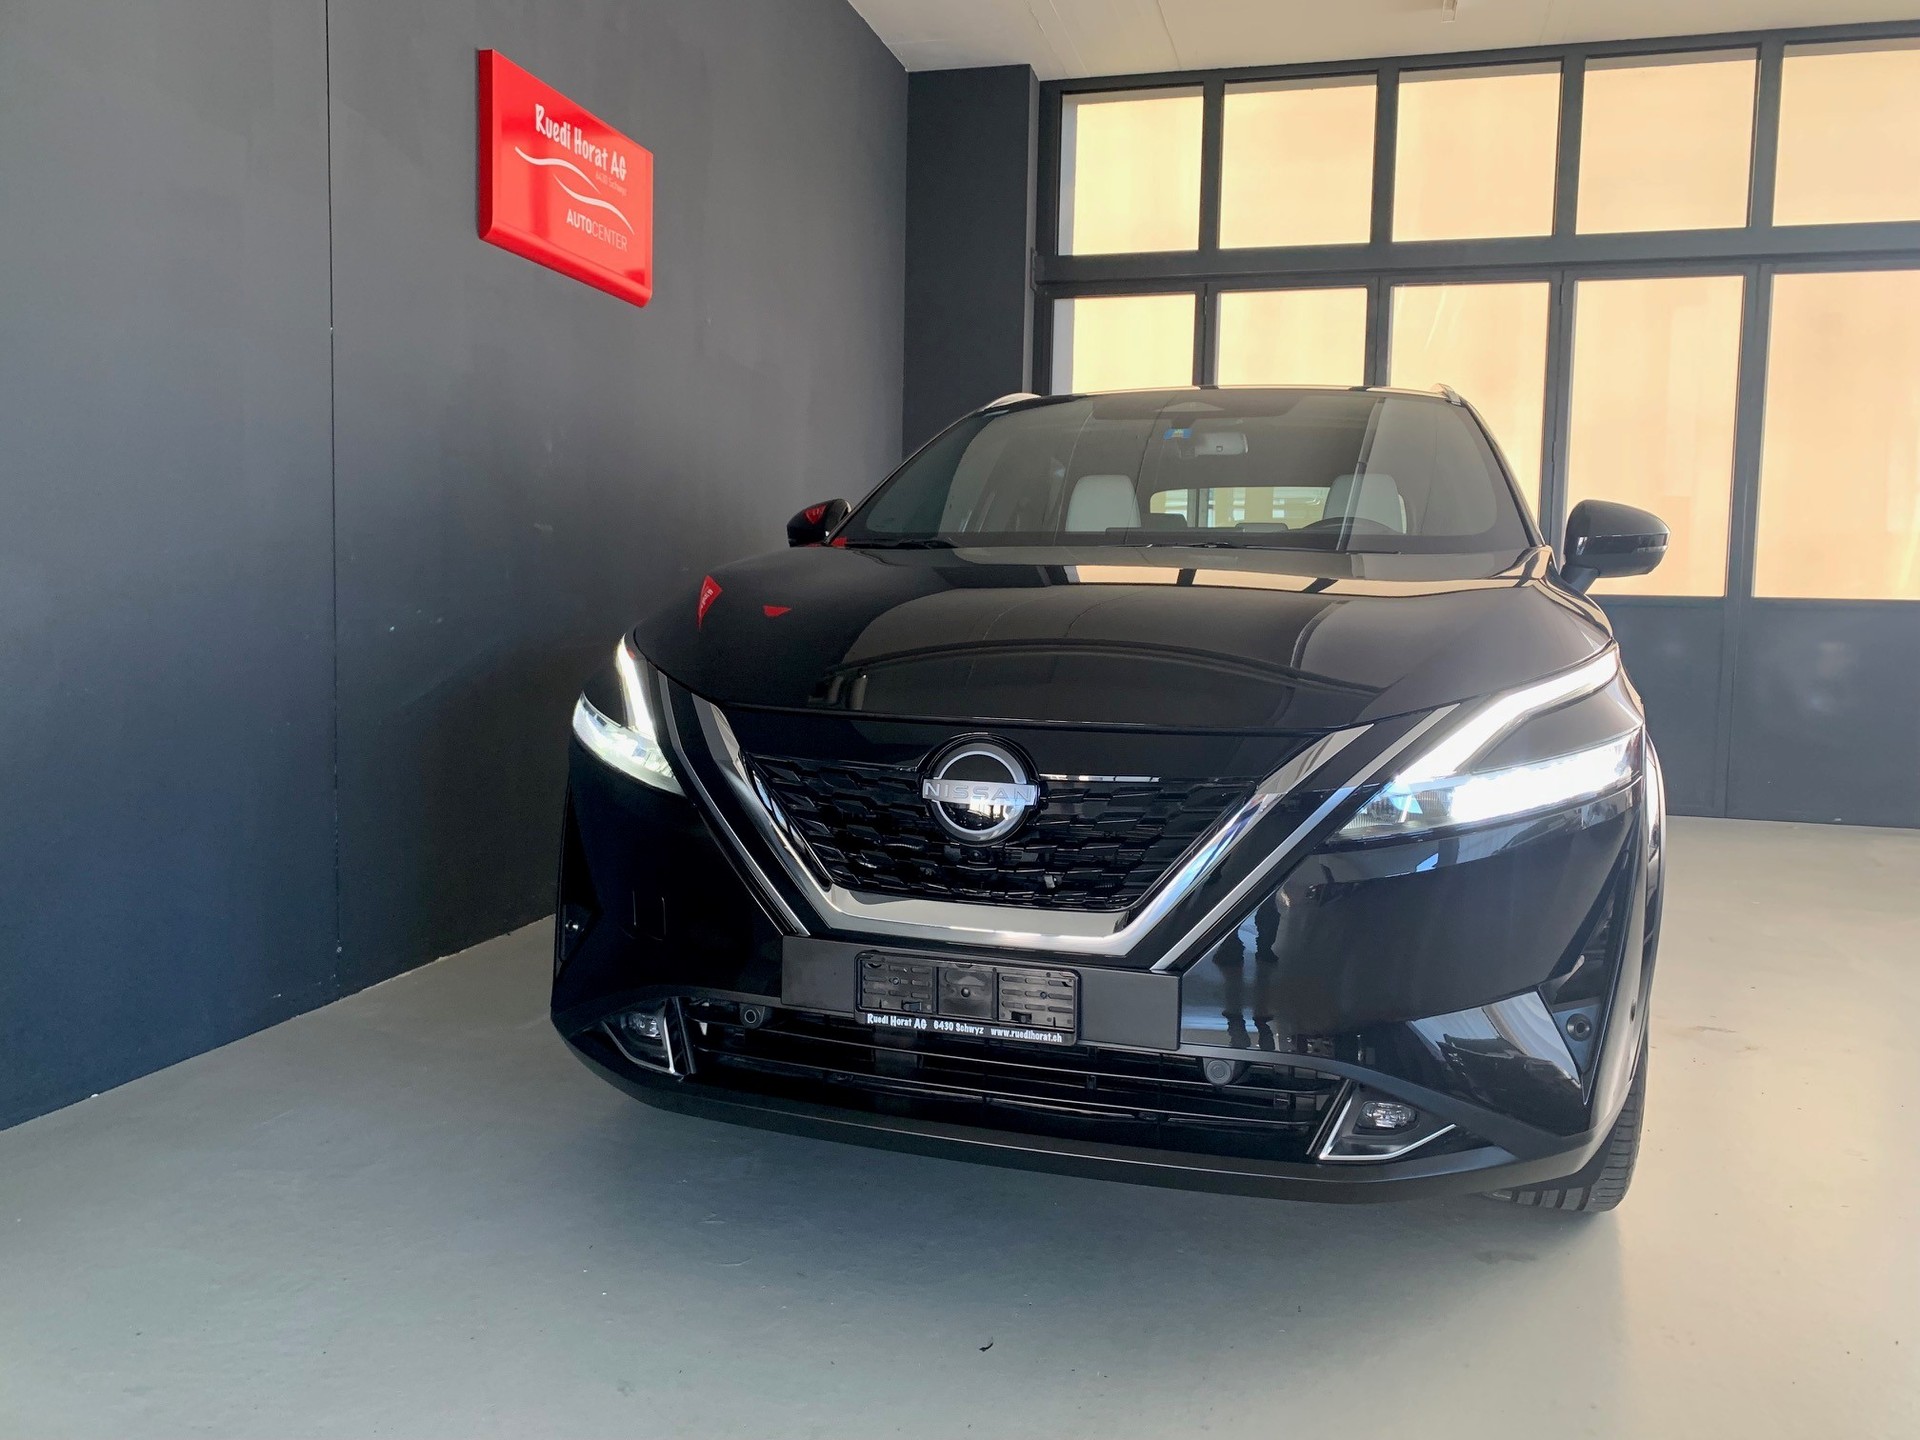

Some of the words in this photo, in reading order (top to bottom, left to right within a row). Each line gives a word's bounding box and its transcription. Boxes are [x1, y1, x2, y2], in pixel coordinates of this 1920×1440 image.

[535, 104, 571, 150] Ruedi
[574, 127, 608, 171] Horat
[610, 152, 627, 181] AG
[566, 209, 628, 251] AUTOCENTER
[924, 782, 1032, 802] NISSAN
[867, 1013, 889, 1025] Ruedi
[890, 1015, 912, 1027] Horat
[914, 1018, 927, 1030] AG
[933, 1020, 954, 1031] 6430
[955, 1022, 985, 1035] Schwyz
[990, 1027, 1063, 1043] www.ruedihorat.ch
